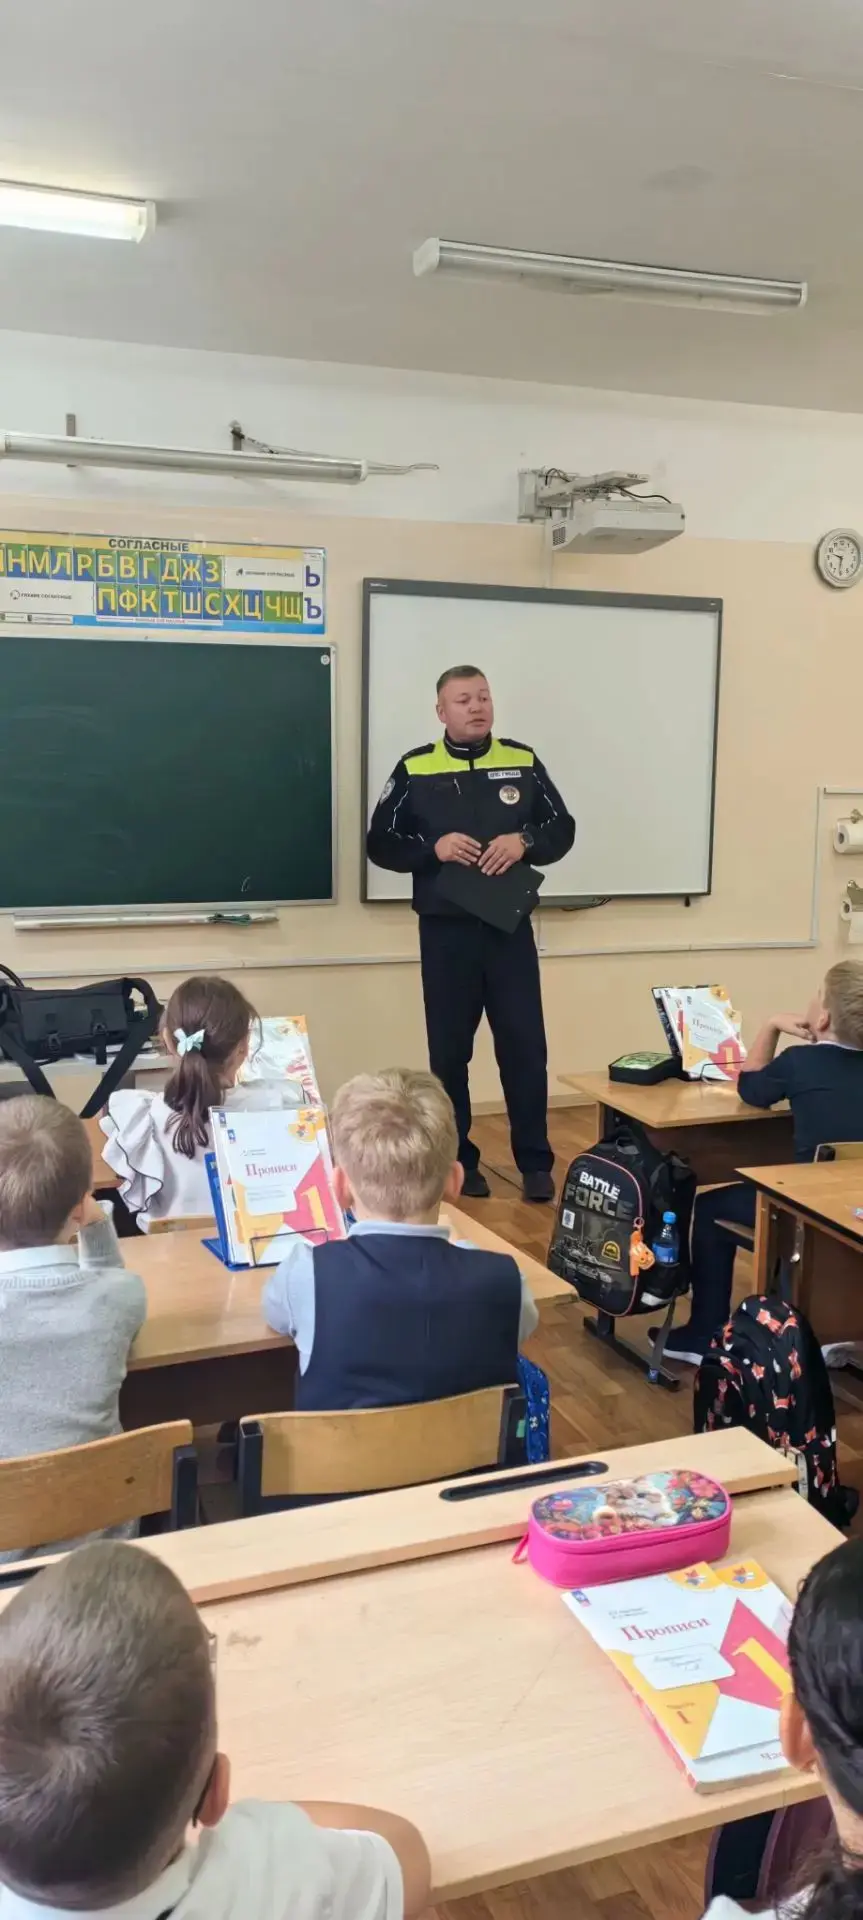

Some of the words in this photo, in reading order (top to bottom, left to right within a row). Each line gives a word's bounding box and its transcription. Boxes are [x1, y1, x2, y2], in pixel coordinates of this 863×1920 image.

[108, 538, 189, 552] СОГЛАСНЫЕ
[305, 564, 321, 588] Ь
[304, 597, 322, 619] Ъ
[579, 1171, 620, 1200] BATTLE
[299, 1184, 334, 1232] 1
[564, 1182, 634, 1219] FORCE
[619, 1617, 711, 1641] Прописи
[731, 1636, 794, 1702] 1
